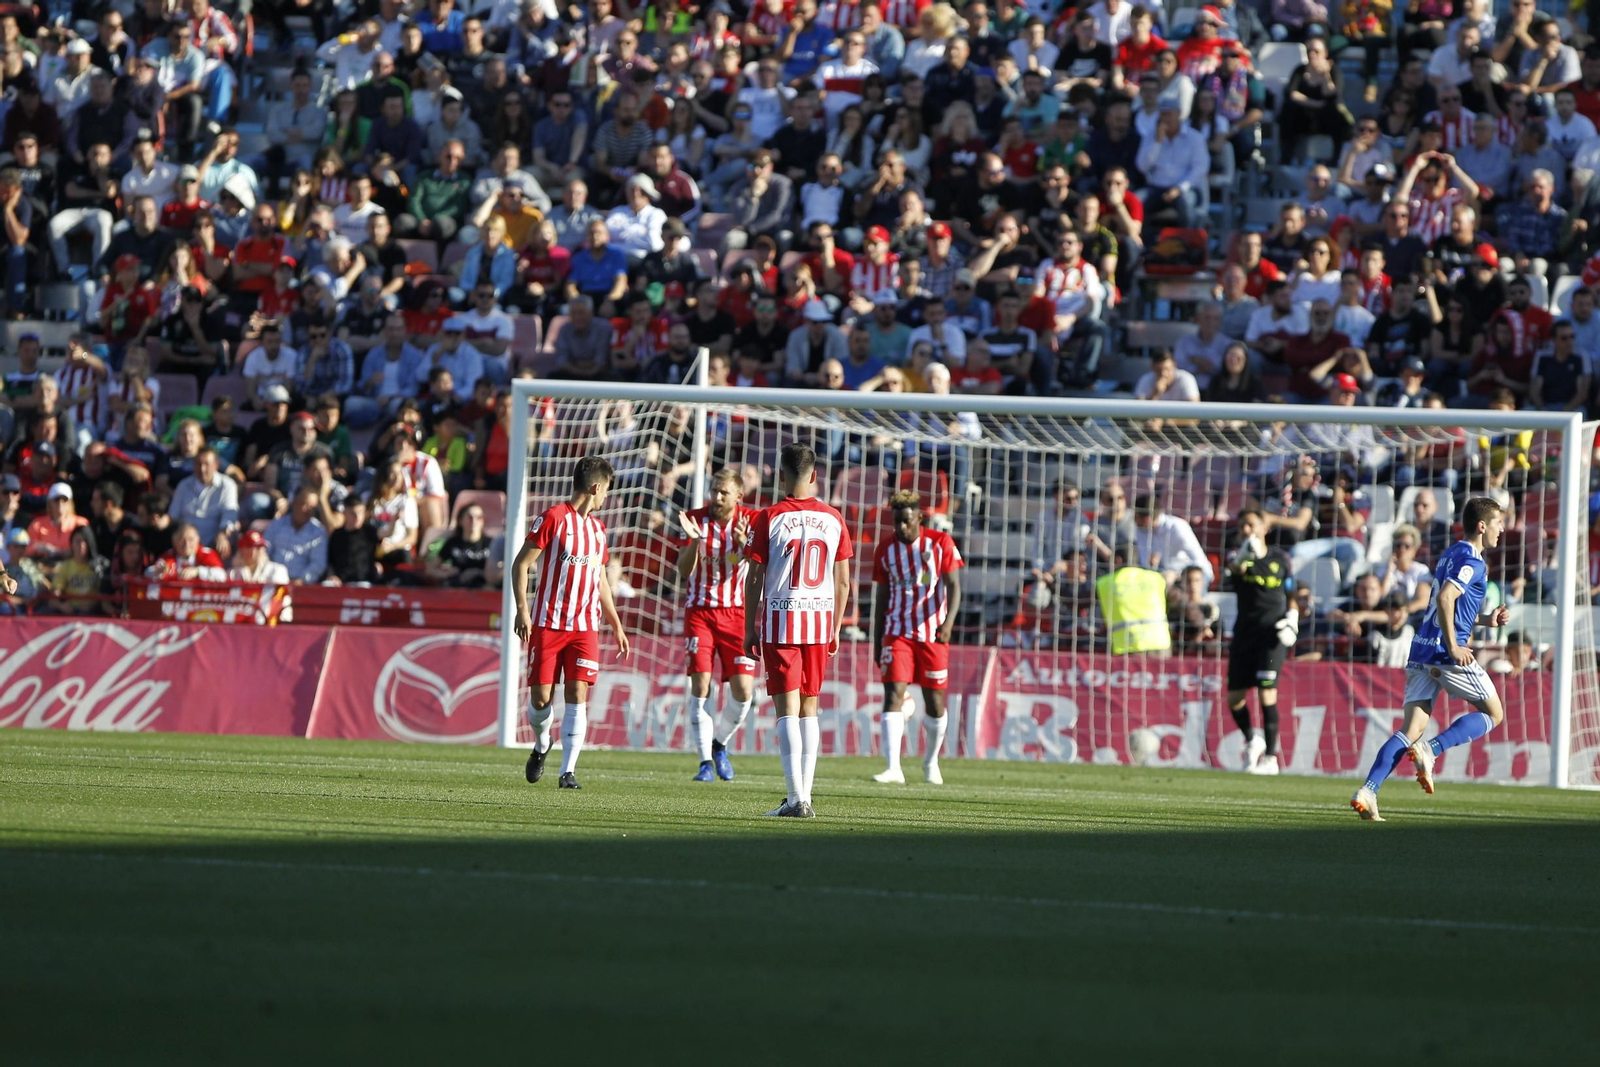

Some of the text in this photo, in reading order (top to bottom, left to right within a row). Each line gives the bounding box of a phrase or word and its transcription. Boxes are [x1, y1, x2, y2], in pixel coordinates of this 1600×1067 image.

[785, 538, 828, 590] 10
[779, 599, 802, 610] COSTA
[1004, 659, 1222, 692] Autocares
